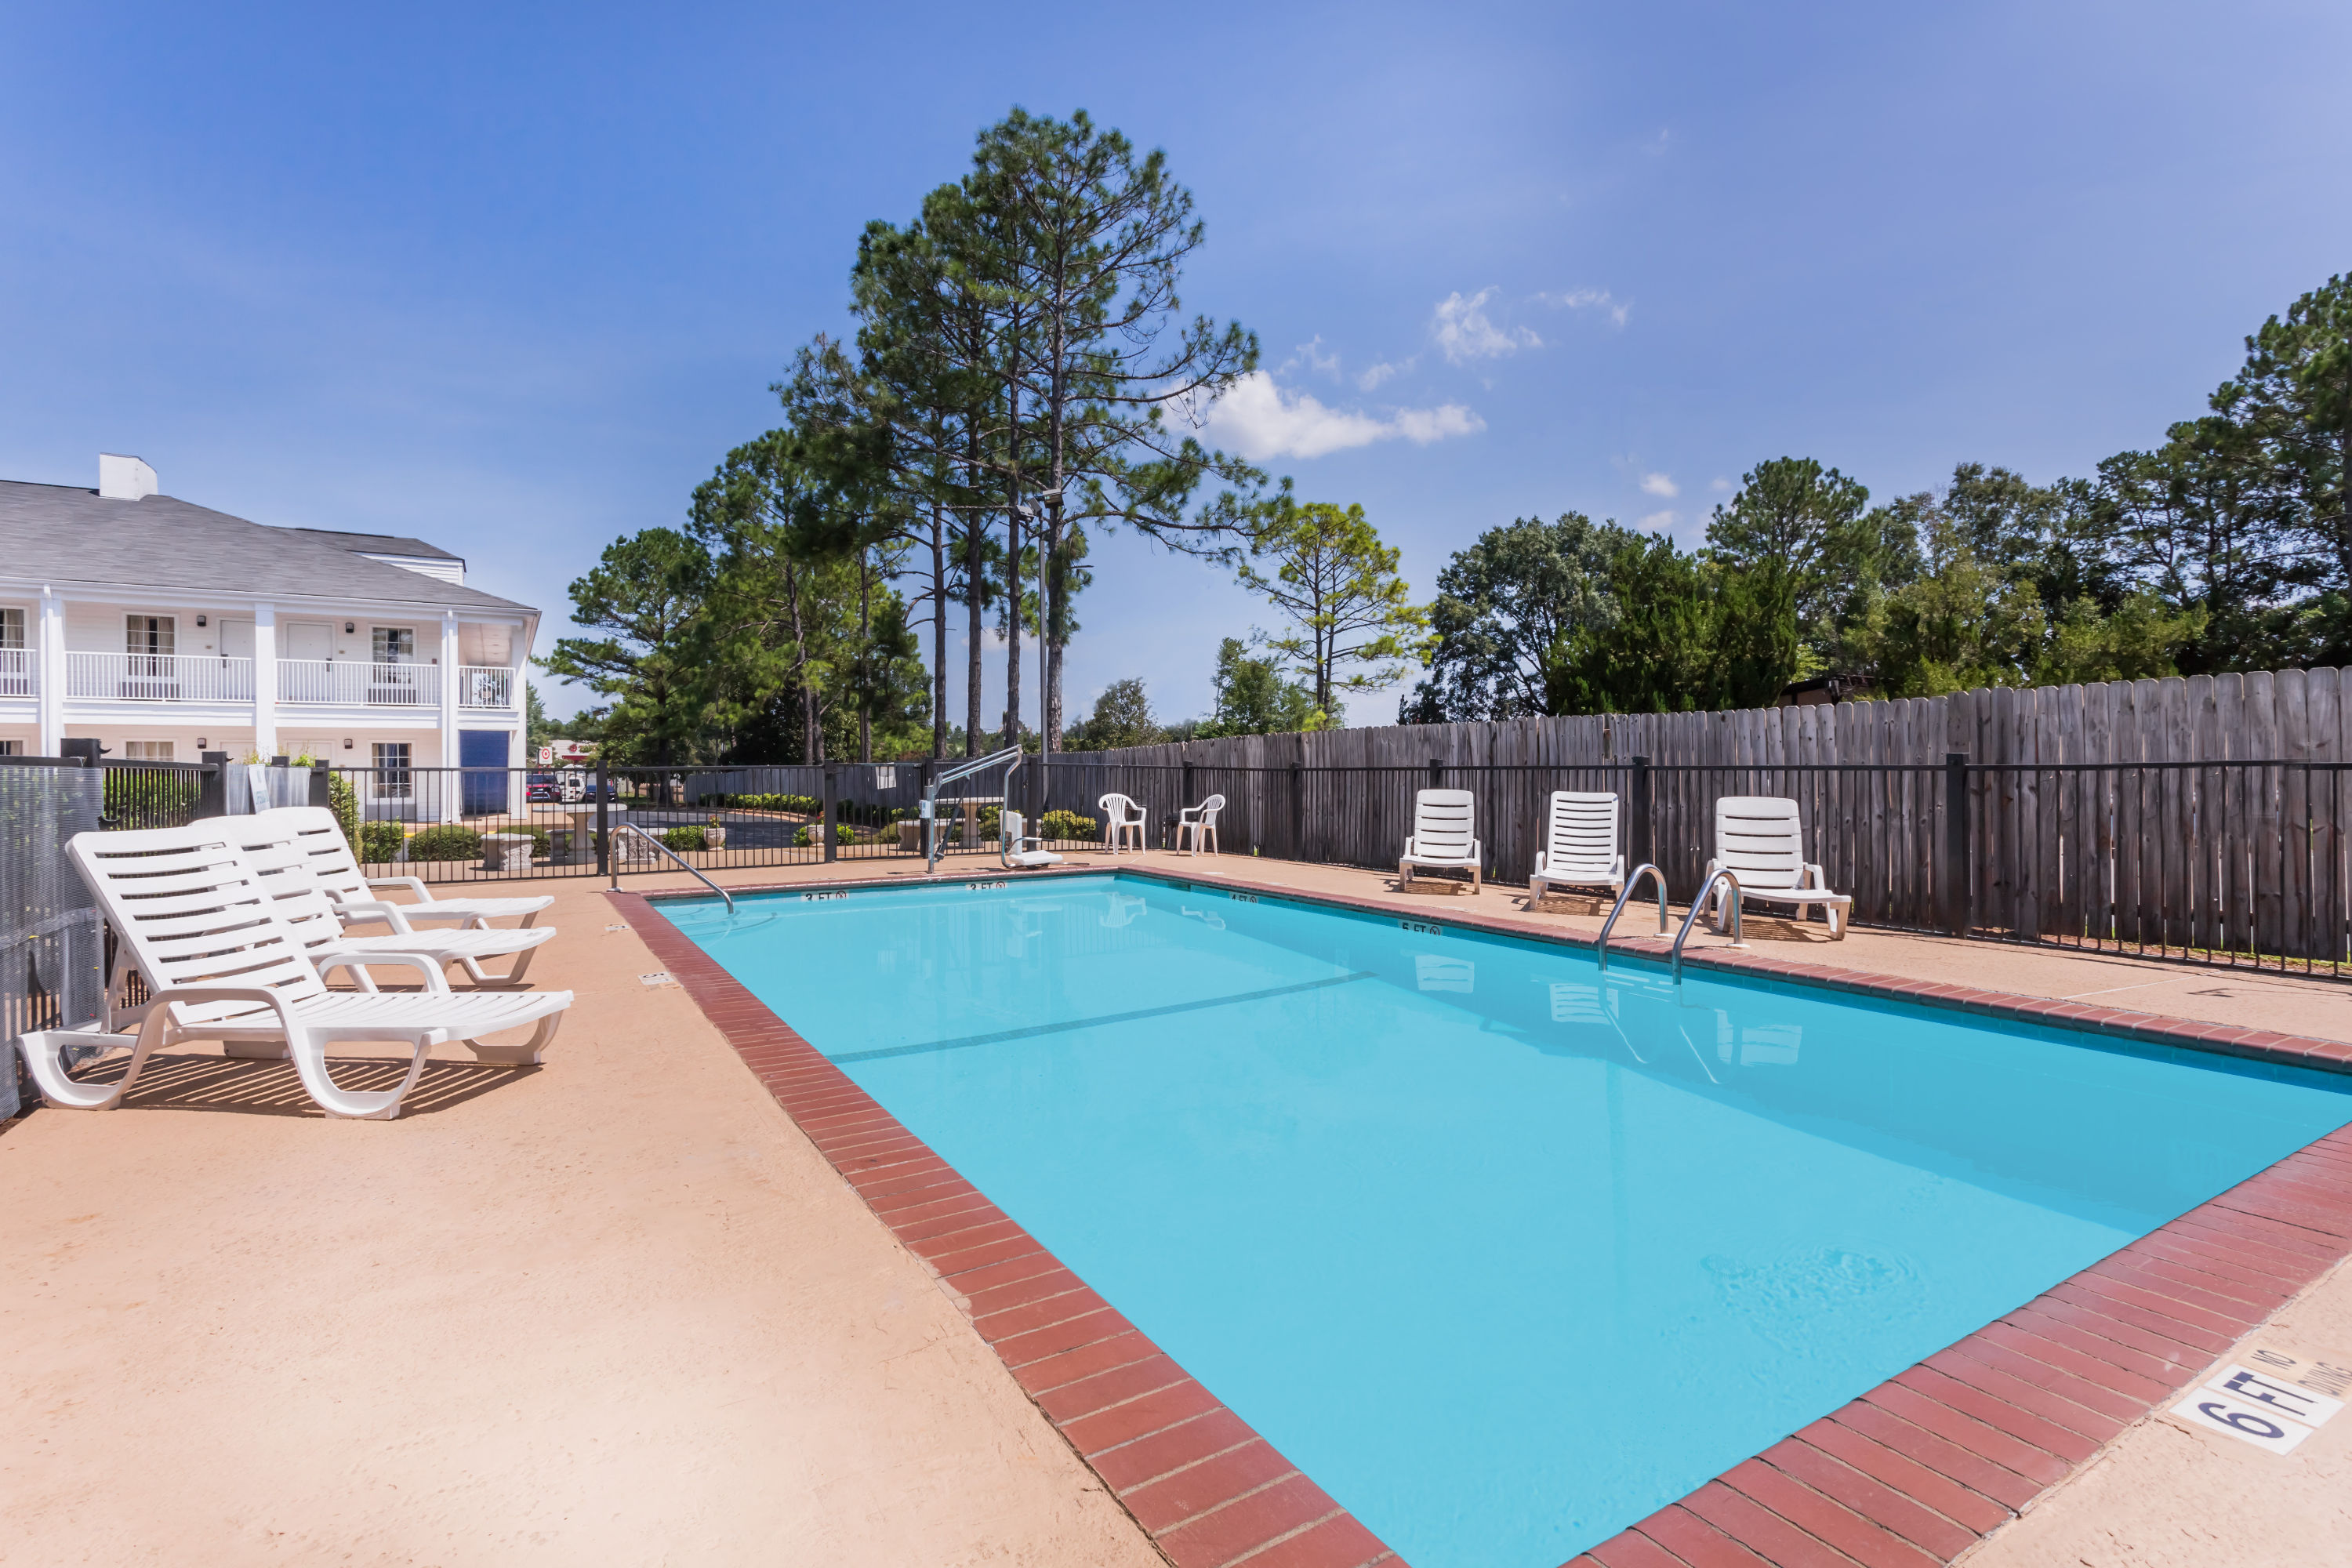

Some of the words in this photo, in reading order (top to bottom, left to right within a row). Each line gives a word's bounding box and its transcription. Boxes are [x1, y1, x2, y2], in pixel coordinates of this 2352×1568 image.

[818, 892, 832, 901] FT
[1414, 924, 1426, 933] FT
[2250, 1349, 2297, 1370] NO
[2296, 1361, 2352, 1396] DIVING
[2223, 1371, 2318, 1417] FT
[2198, 1402, 2285, 1439] 6
